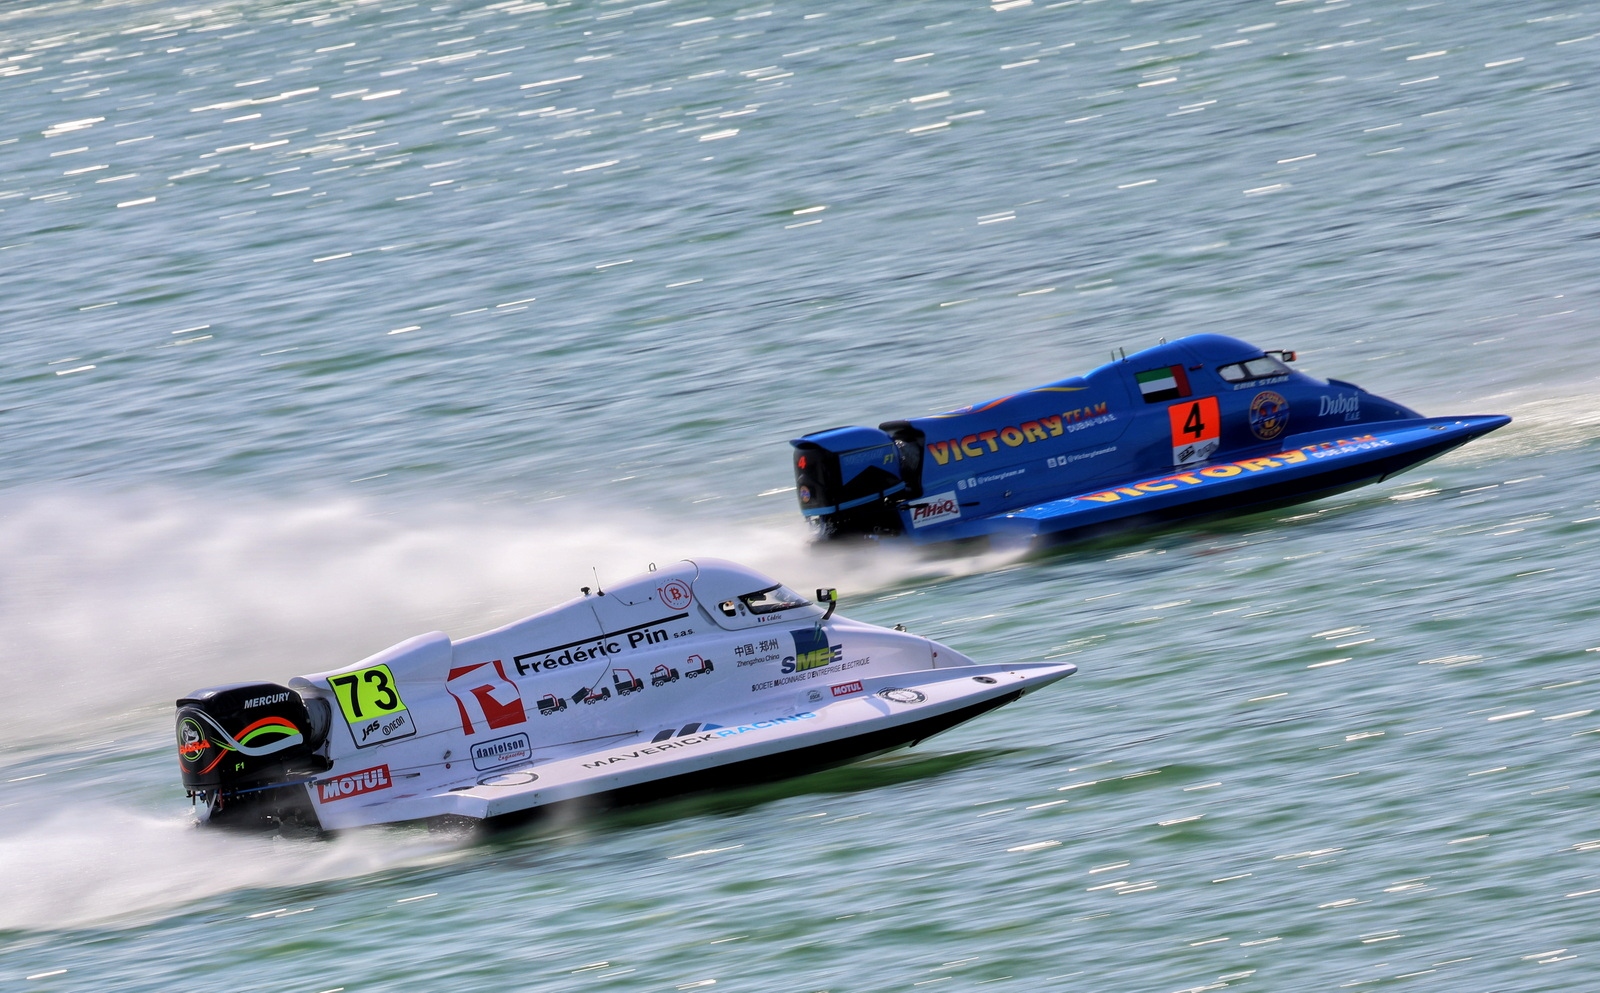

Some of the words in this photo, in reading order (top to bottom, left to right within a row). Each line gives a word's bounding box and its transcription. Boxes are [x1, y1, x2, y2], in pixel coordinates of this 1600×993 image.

[1319, 391, 1359, 417] Dubai
[1183, 402, 1205, 438] 4
[927, 416, 1063, 466] VICTORY
[1062, 402, 1109, 424] TEAM
[797, 455, 807, 469] 4
[882, 454, 894, 465] F1
[1074, 449, 1308, 502] VICTORY
[513, 640, 622, 676] Frédéric
[627, 627, 669, 649] Pin
[673, 628, 696, 639] s.a.s.
[734, 638, 779, 657] 中国·郑州
[736, 656, 766, 668] Zhengzhou
[766, 654, 780, 662] China
[752, 681, 774, 692] SOCIETE
[773, 674, 807, 687] MACONNAISE
[807, 665, 841, 680] D'ENTREPRISE
[841, 657, 870, 671] ELECTRIQUE
[333, 670, 399, 718] 73
[833, 682, 861, 695] MOTUL
[244, 691, 290, 710] MERCURY
[362, 720, 381, 742] JAS
[476, 740, 525, 759] danielson
[235, 761, 245, 772] F1
[322, 768, 390, 800] MOTUL
